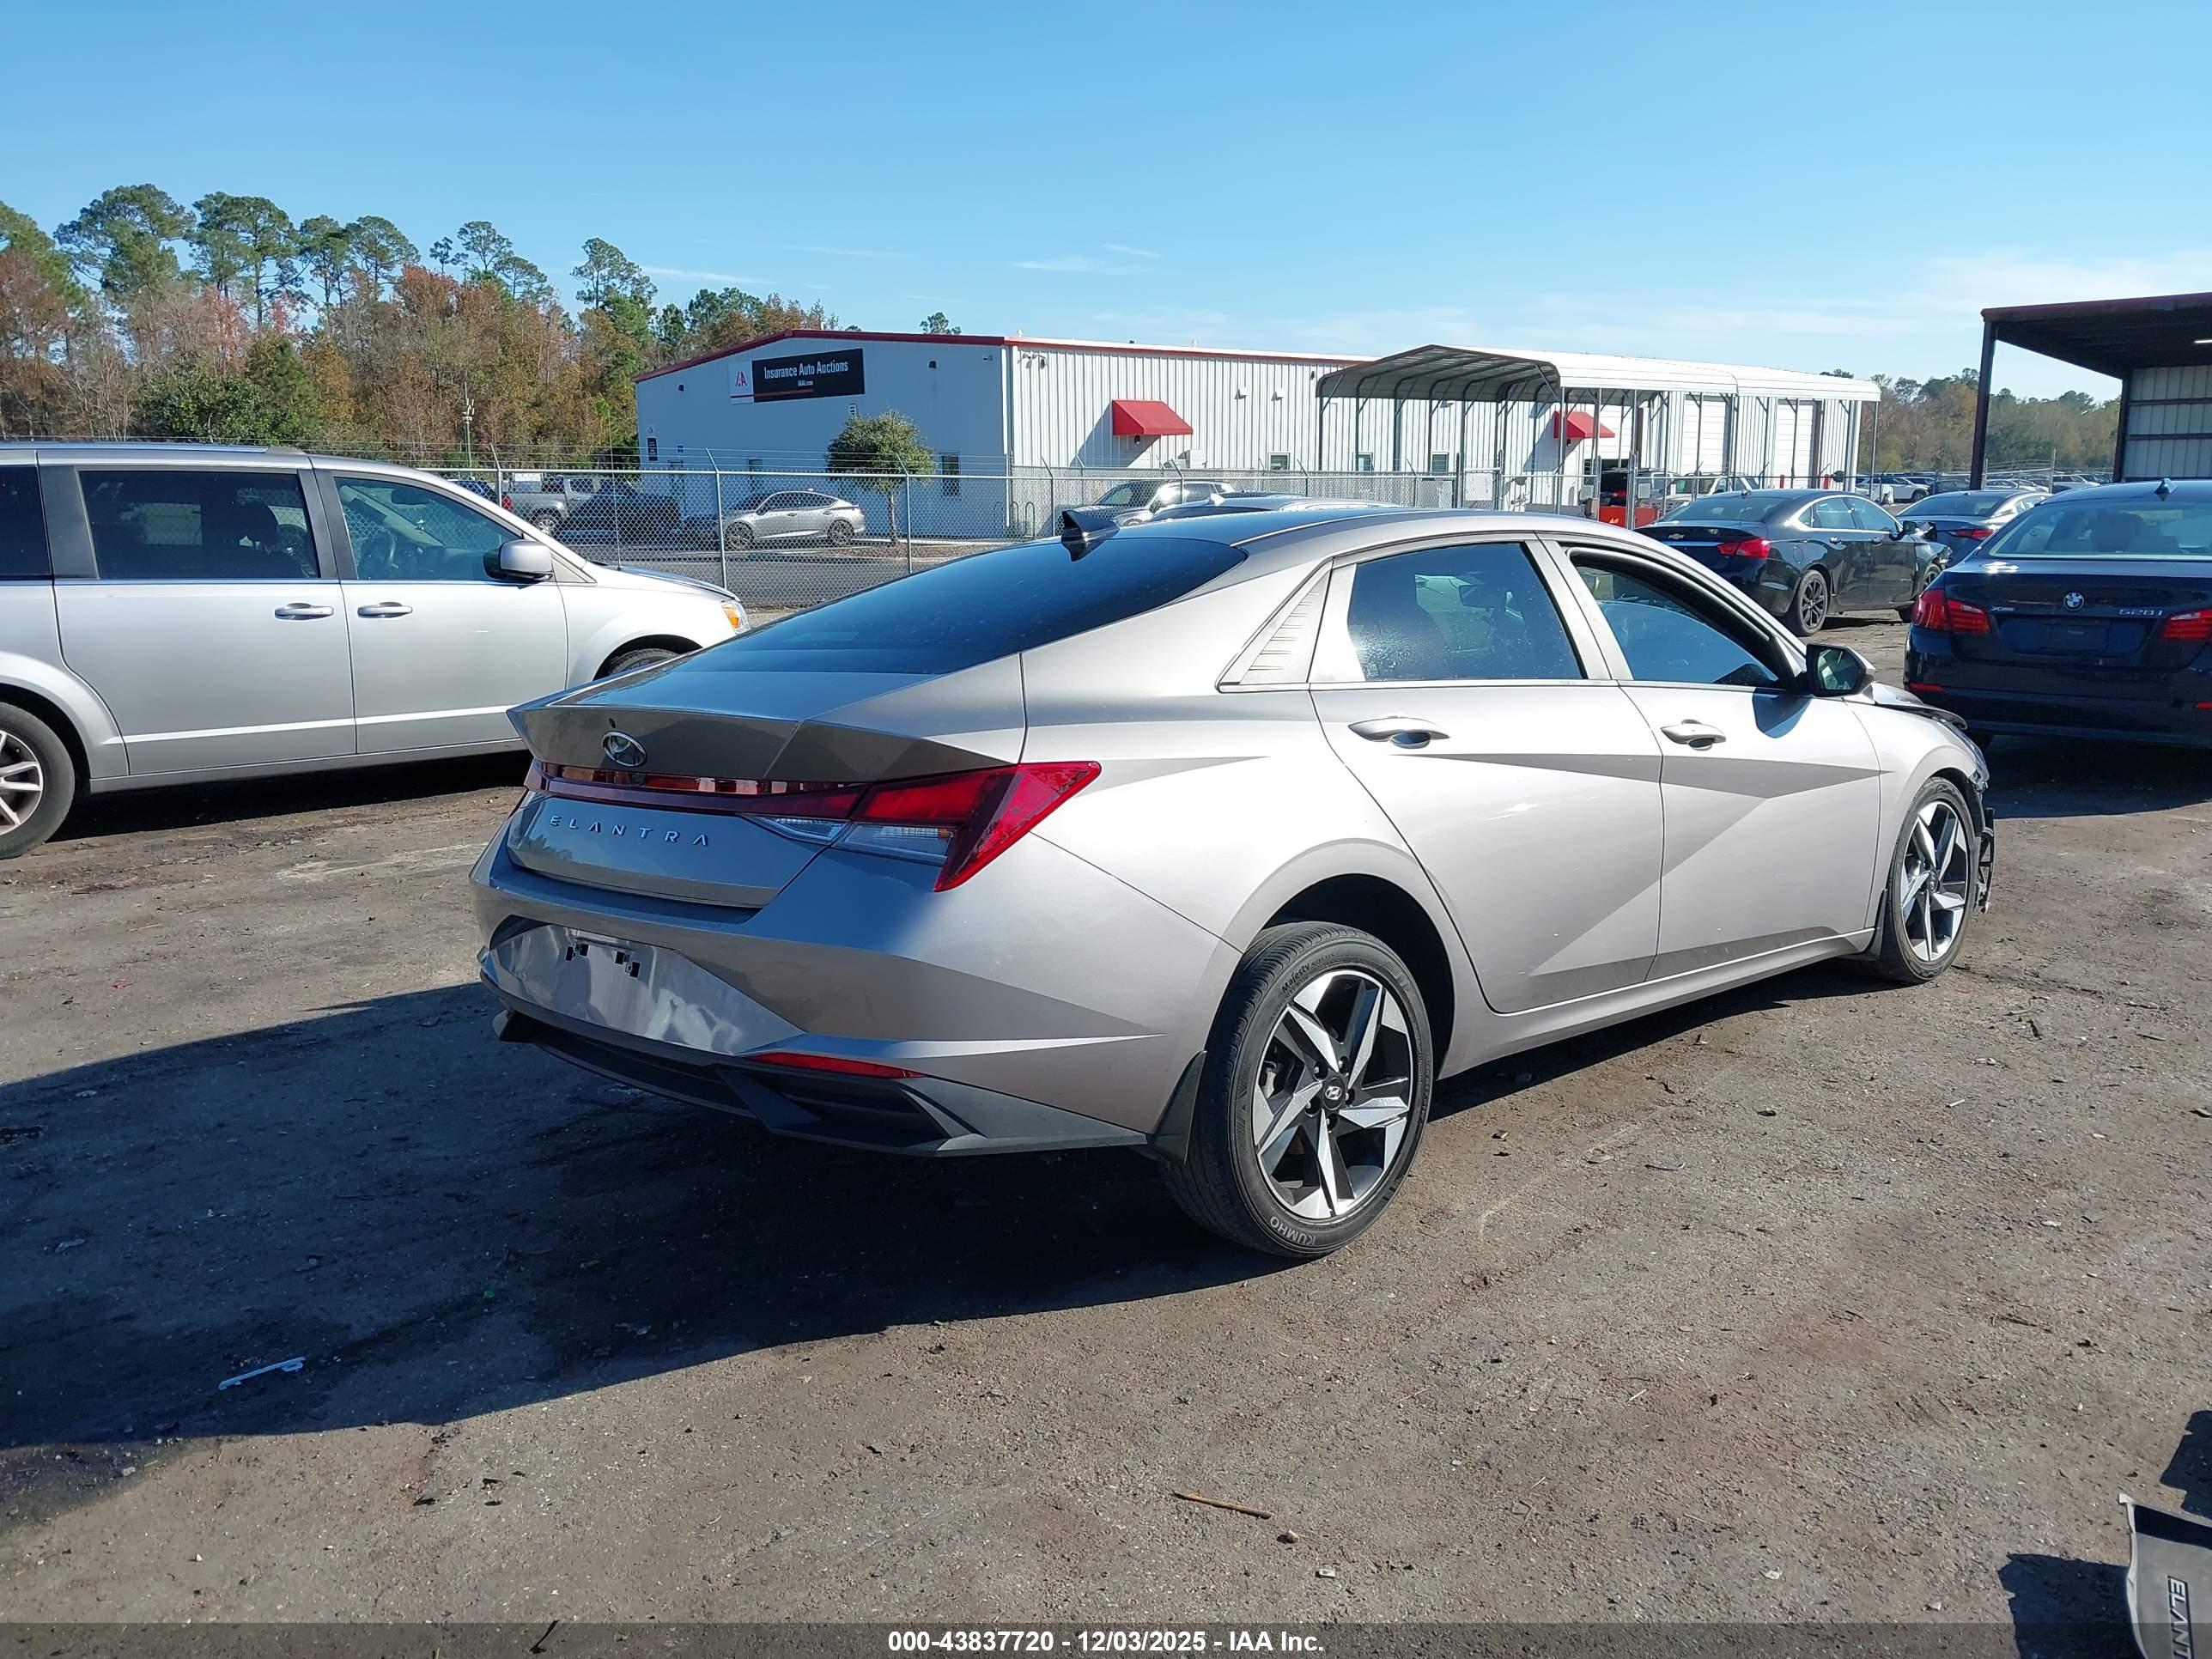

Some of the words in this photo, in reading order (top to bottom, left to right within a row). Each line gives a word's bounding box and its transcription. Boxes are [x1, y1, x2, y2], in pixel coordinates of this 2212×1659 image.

[764, 366, 797, 379] Insurance
[799, 362, 815, 375] Auto
[817, 360, 848, 374] Auctions
[550, 816, 708, 846] ELANTRA
[1270, 1216, 1316, 1246] KUMHO
